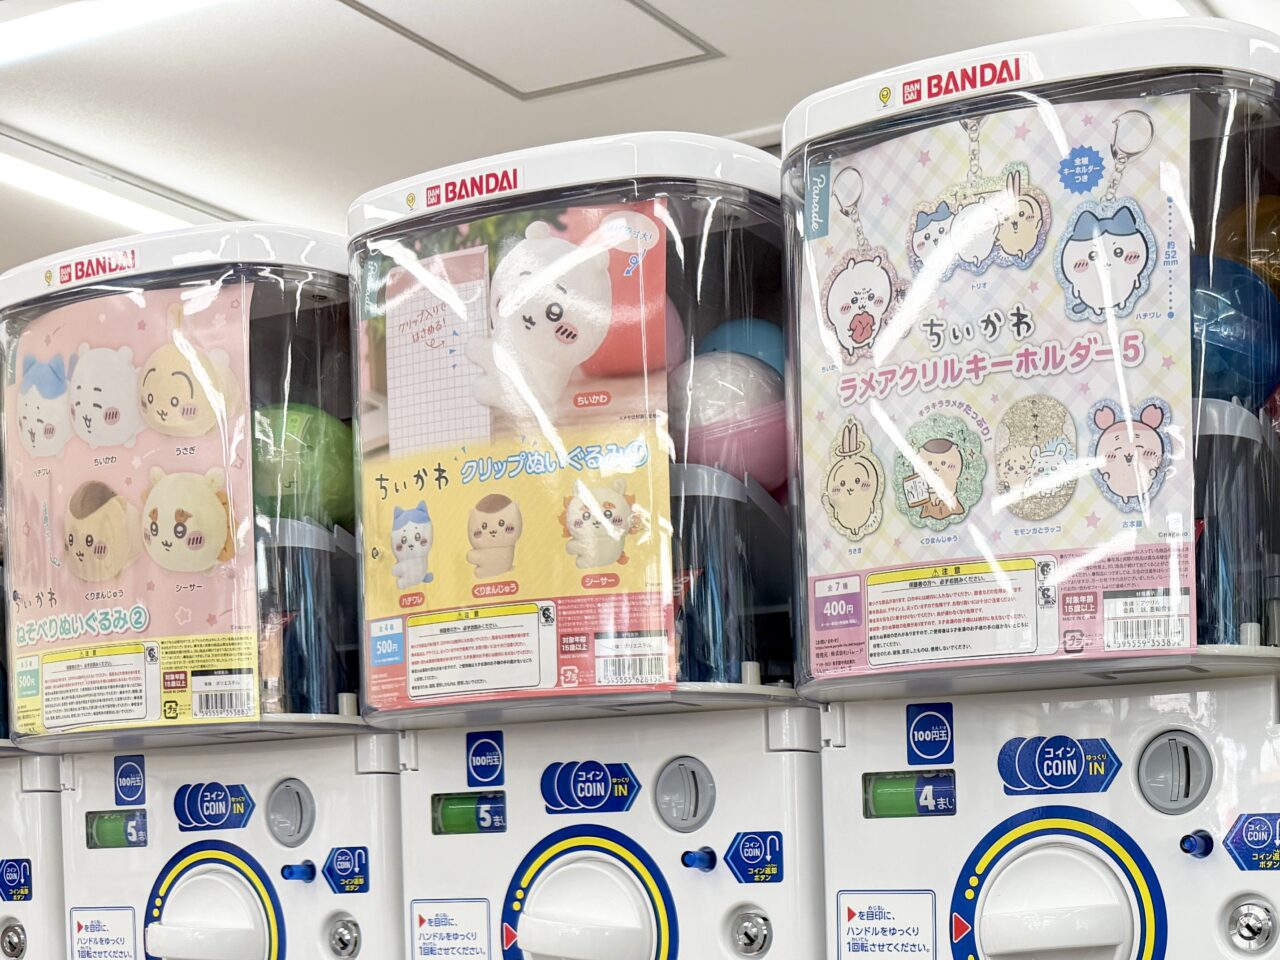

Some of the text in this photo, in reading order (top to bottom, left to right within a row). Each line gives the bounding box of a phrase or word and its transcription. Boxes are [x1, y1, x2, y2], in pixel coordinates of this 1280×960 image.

[927, 58, 1021, 98] BANDAI
[1062, 165, 1100, 176] キーホルダー
[1074, 175, 1088, 183] つき
[445, 169, 518, 203] BANDAI
[1164, 250, 1178, 259] 52
[971, 282, 987, 290] トリオ
[1135, 310, 1162, 320] ハチワレ
[922, 304, 1035, 350] ちいかわ
[838, 332, 1143, 401] ラメアクリルキーホルダー5
[577, 394, 608, 405] ちいかわ
[375, 462, 449, 500] ちいかわ
[1014, 526, 1062, 535] モモンガとラッコ
[920, 535, 958, 545] くりまんじゅう
[585, 576, 616, 586] シーサー
[175, 584, 203, 592] シーサー
[473, 583, 517, 595] くりまんじゅう
[84, 589, 124, 600] くりまんじゅう
[1065, 596, 1094, 604] 対象年齢
[401, 595, 423, 606] ハチワレ
[823, 600, 853, 617] 400円
[1064, 604, 1095, 612] 15歳以上
[375, 641, 398, 654] 500円
[913, 728, 948, 741] 100円玉
[1045, 748, 1075, 759] コイン
[471, 755, 500, 766] 100円玉
[1043, 759, 1078, 776] COIN
[1088, 761, 1105, 775] IN
[119, 777, 142, 786] 100円玉
[578, 771, 603, 781] コイン
[577, 781, 605, 797] COIN
[614, 784, 628, 796] IN
[204, 791, 225, 801] コイン
[203, 801, 226, 815] COIN
[232, 803, 244, 814] IN
[128, 821, 137, 842] 5
[1247, 831, 1270, 842] COIN
[743, 847, 761, 856] COIN
[857, 909, 896, 922] を目印に、
[418, 931, 477, 942] ハンドルをゆっくり
[847, 926, 920, 937] ハンドルをゆっくり
[77, 937, 126, 946] ハンドルをゆっくり
[847, 939, 931, 953] 1回転させてください。
[77, 949, 134, 959] 1回転させてください。
[418, 944, 487, 956] 1回転させてください。
